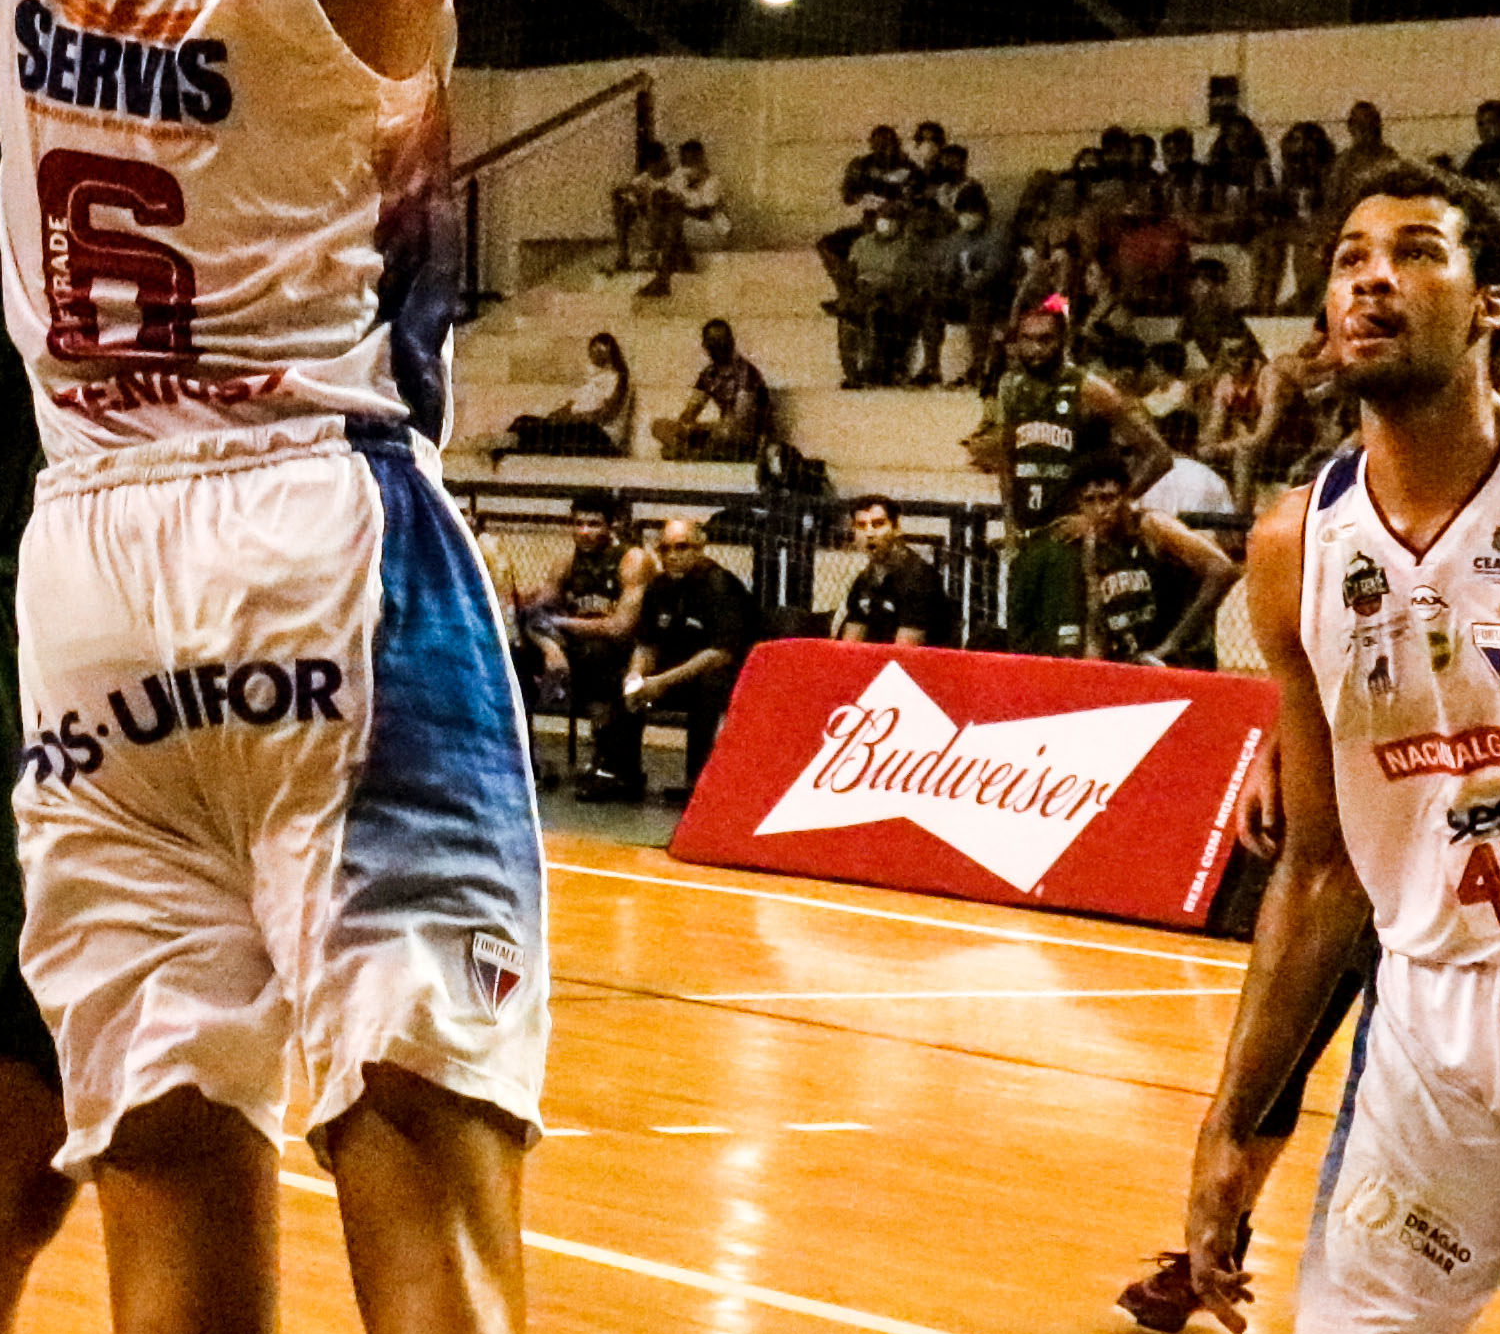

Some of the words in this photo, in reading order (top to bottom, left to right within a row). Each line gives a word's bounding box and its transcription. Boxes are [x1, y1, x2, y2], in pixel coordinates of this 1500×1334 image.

[37, 148, 198, 361] 6
[813, 704, 1113, 821] Budweiser
[1183, 871, 1209, 913] BEBA
[1201, 829, 1223, 868] COM
[1214, 727, 1262, 829] MODERAÇÃO
